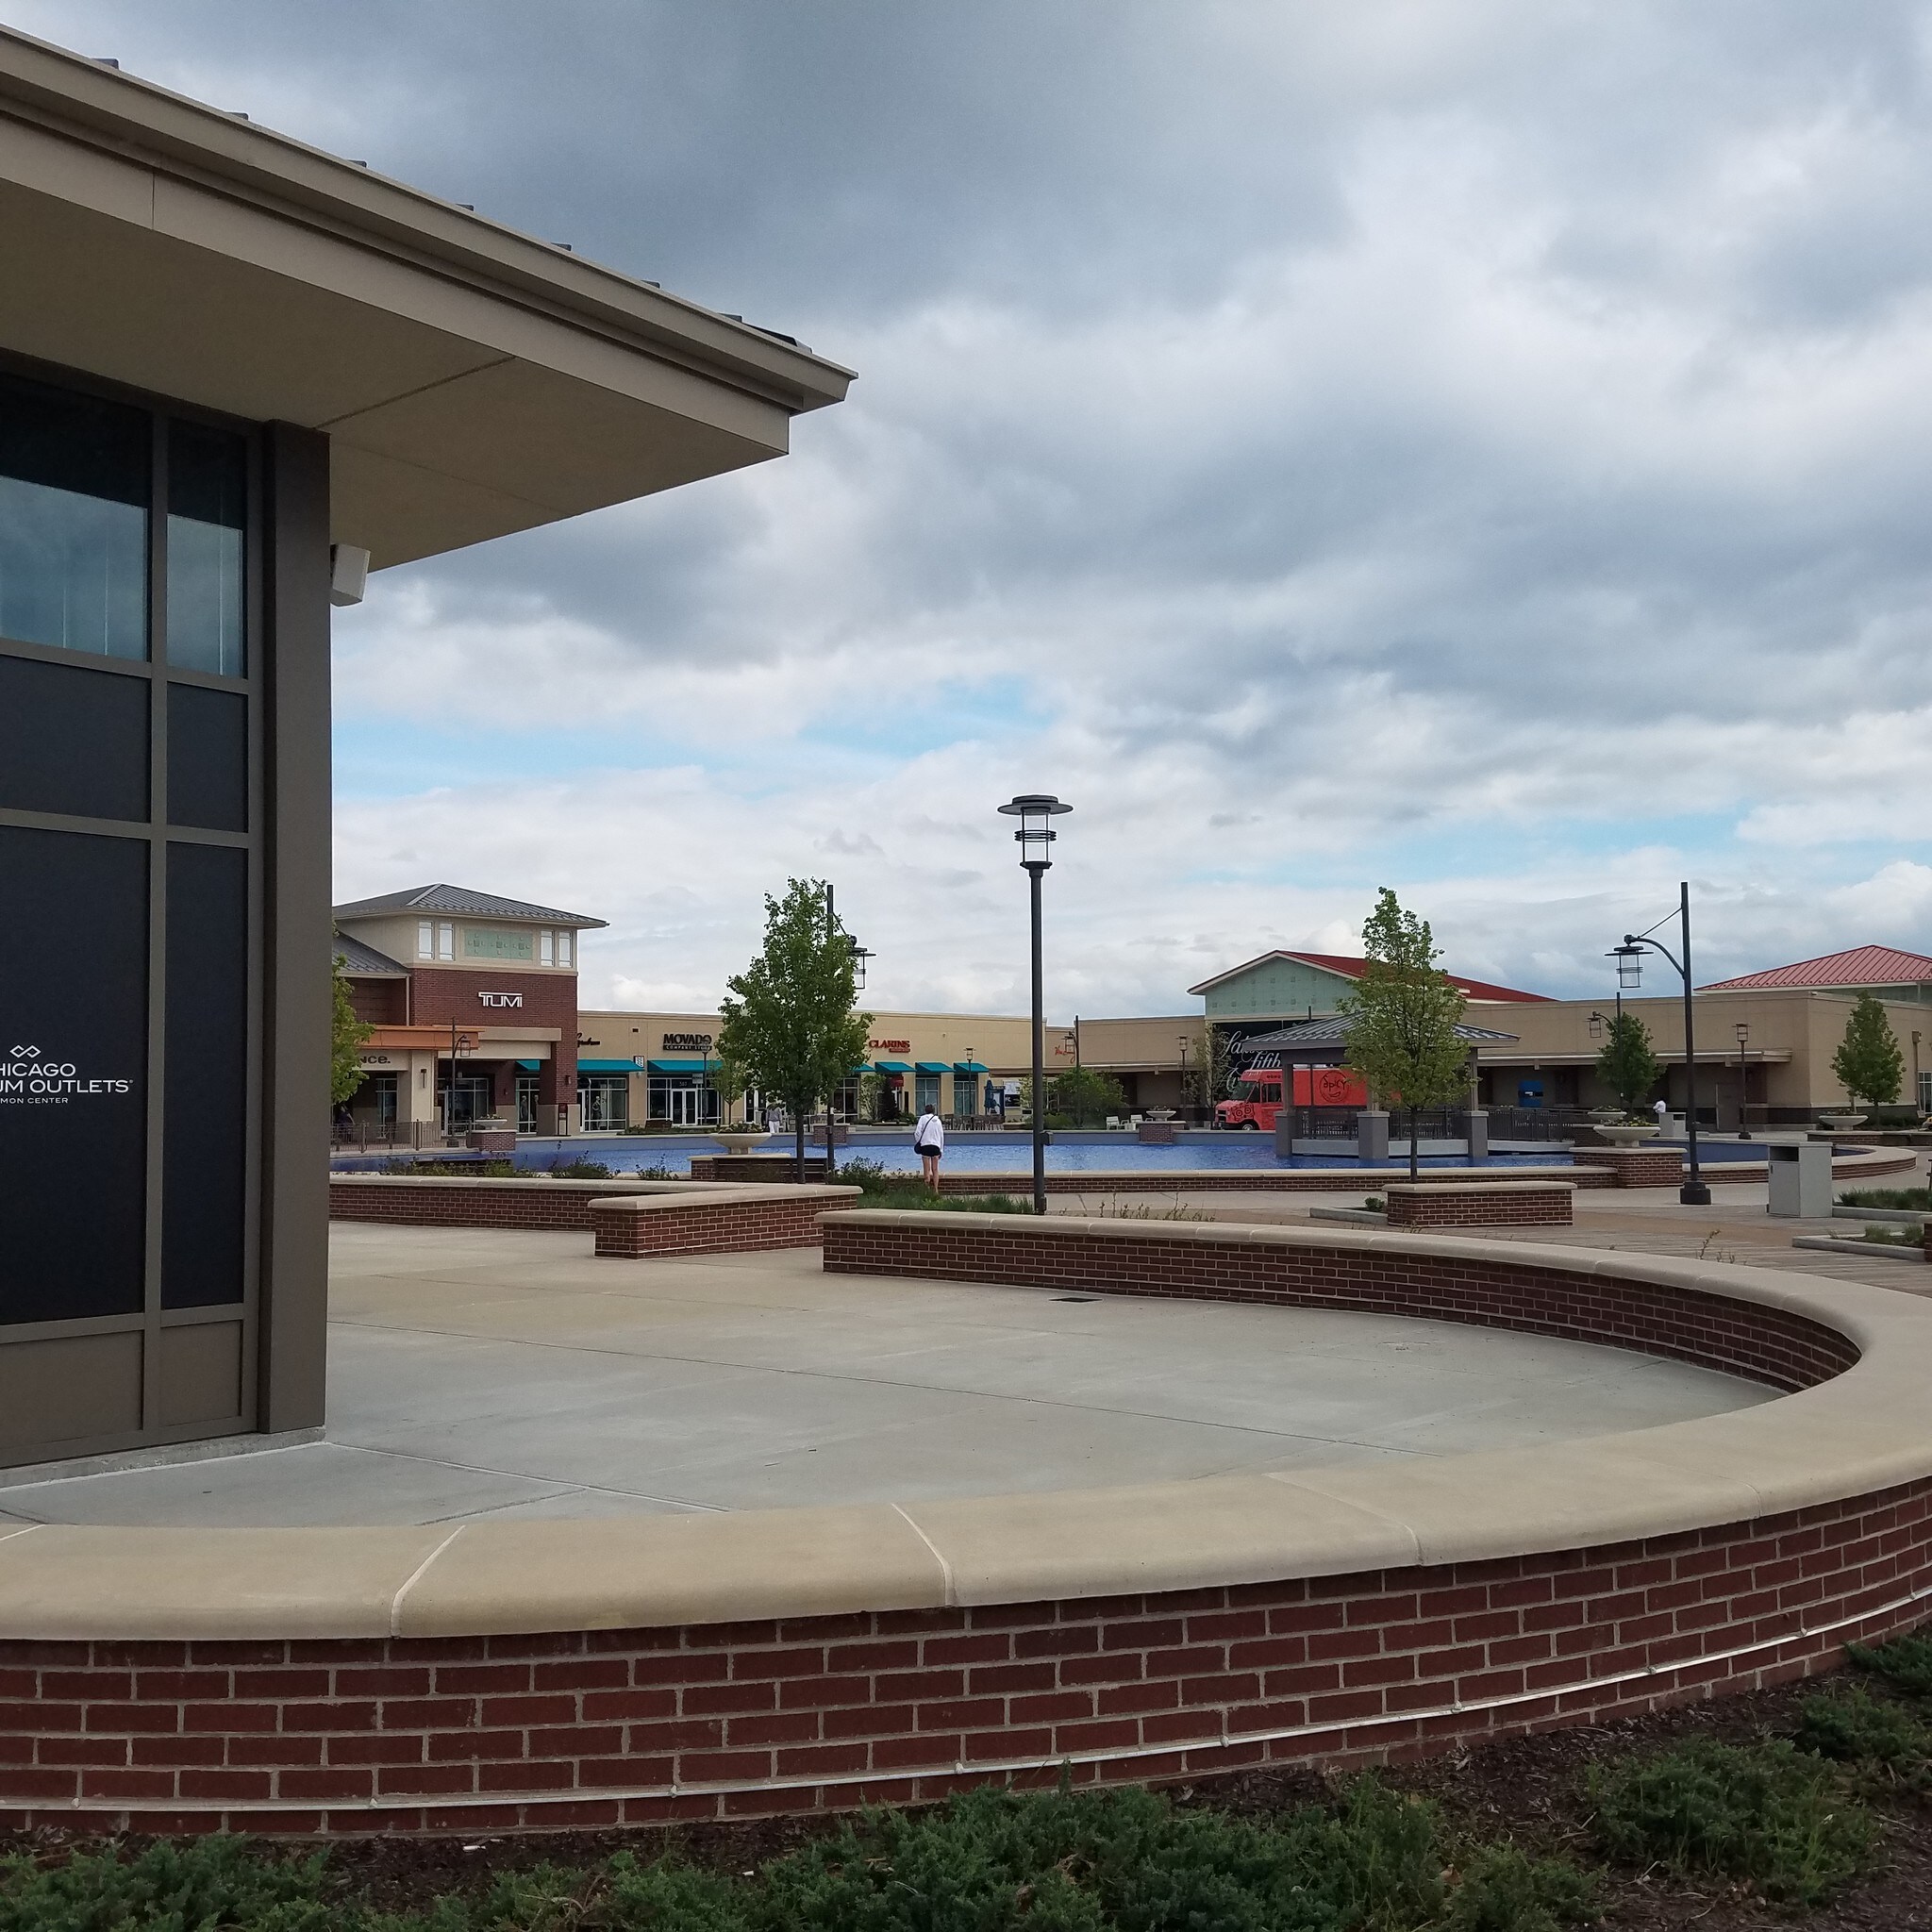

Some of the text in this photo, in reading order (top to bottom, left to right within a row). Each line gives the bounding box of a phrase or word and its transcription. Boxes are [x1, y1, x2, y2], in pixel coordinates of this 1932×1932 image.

[478, 991, 523, 1008] TUMI
[663, 1033, 712, 1045] MOVADO
[869, 1040, 910, 1048] CLARINS
[29, 1079, 129, 1093] OUTLETS
